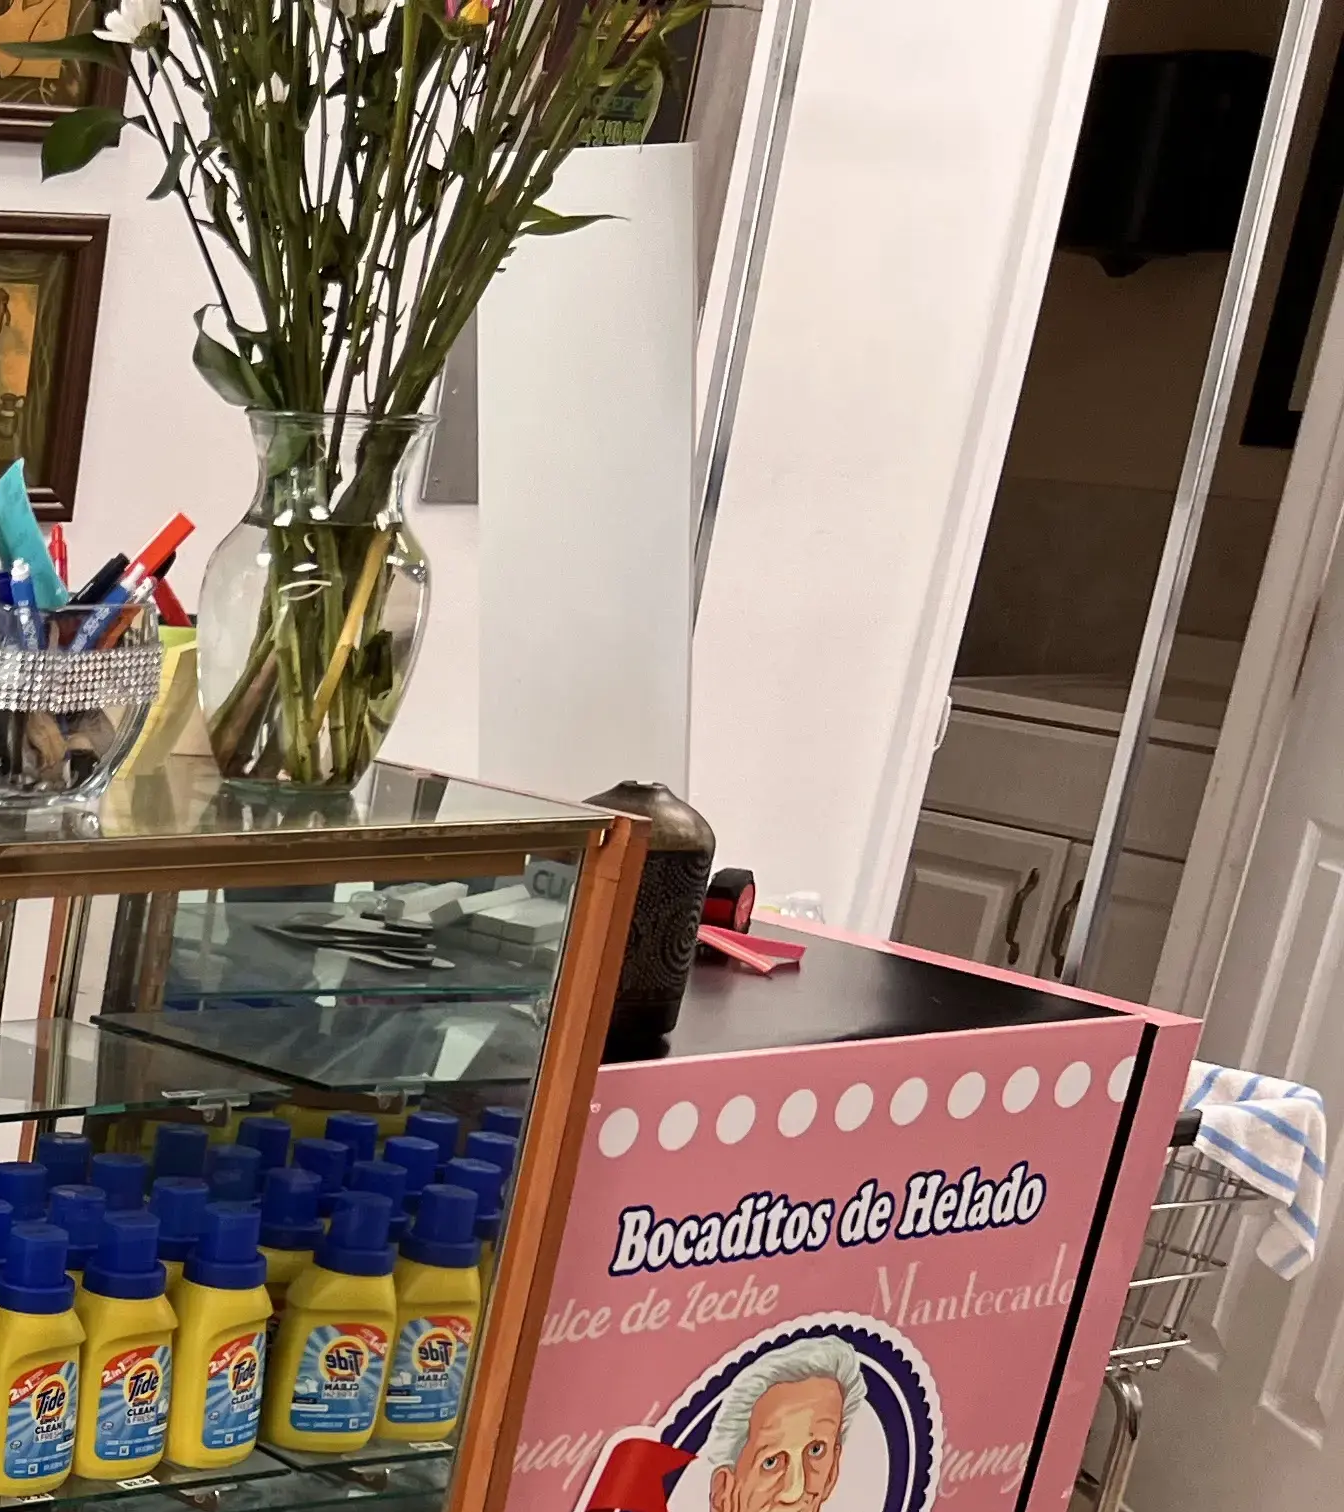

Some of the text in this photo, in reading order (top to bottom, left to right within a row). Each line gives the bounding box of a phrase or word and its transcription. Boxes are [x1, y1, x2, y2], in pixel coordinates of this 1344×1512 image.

[610, 1161, 1047, 1275] Bocaditos de Helado
[872, 1243, 1077, 1327] Mantecado
[540, 1274, 780, 1346] ulce de Leche
[128, 1372, 159, 1401] Tide
[232, 1361, 256, 1390] Tide
[36, 1389, 66, 1419] Tide
[127, 1405, 155, 1417] CLEAN
[231, 1394, 255, 1405] CLEAN
[35, 1422, 62, 1435] CLEAN
